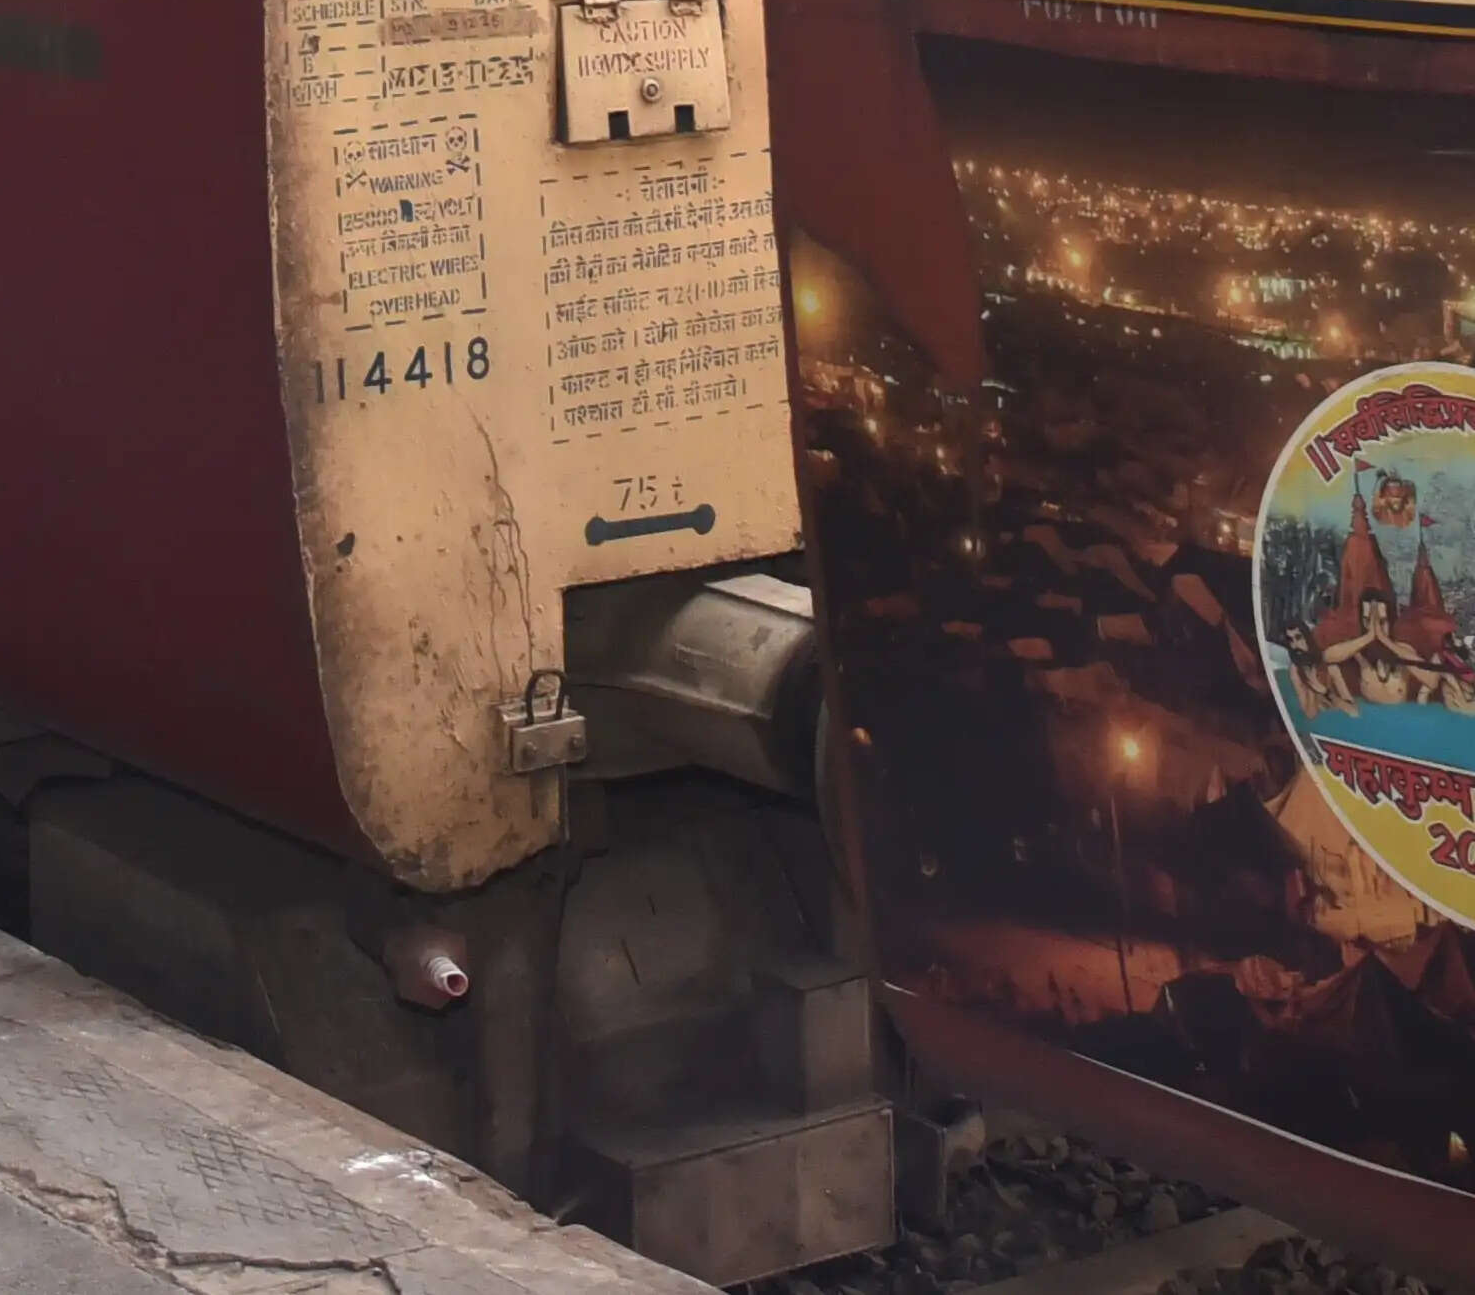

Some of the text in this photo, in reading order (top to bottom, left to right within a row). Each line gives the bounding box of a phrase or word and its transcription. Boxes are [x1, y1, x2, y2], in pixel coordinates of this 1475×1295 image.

[292, 0, 375, 22] SCHEDULE
[600, 18, 687, 44] CAUTION
[366, 133, 437, 161] सावधान
[369, 169, 445, 195] WARNING
[342, 207, 399, 233] 25000
[348, 254, 479, 290] ELECTRIC WIRES
[612, 474, 658, 511] 75
